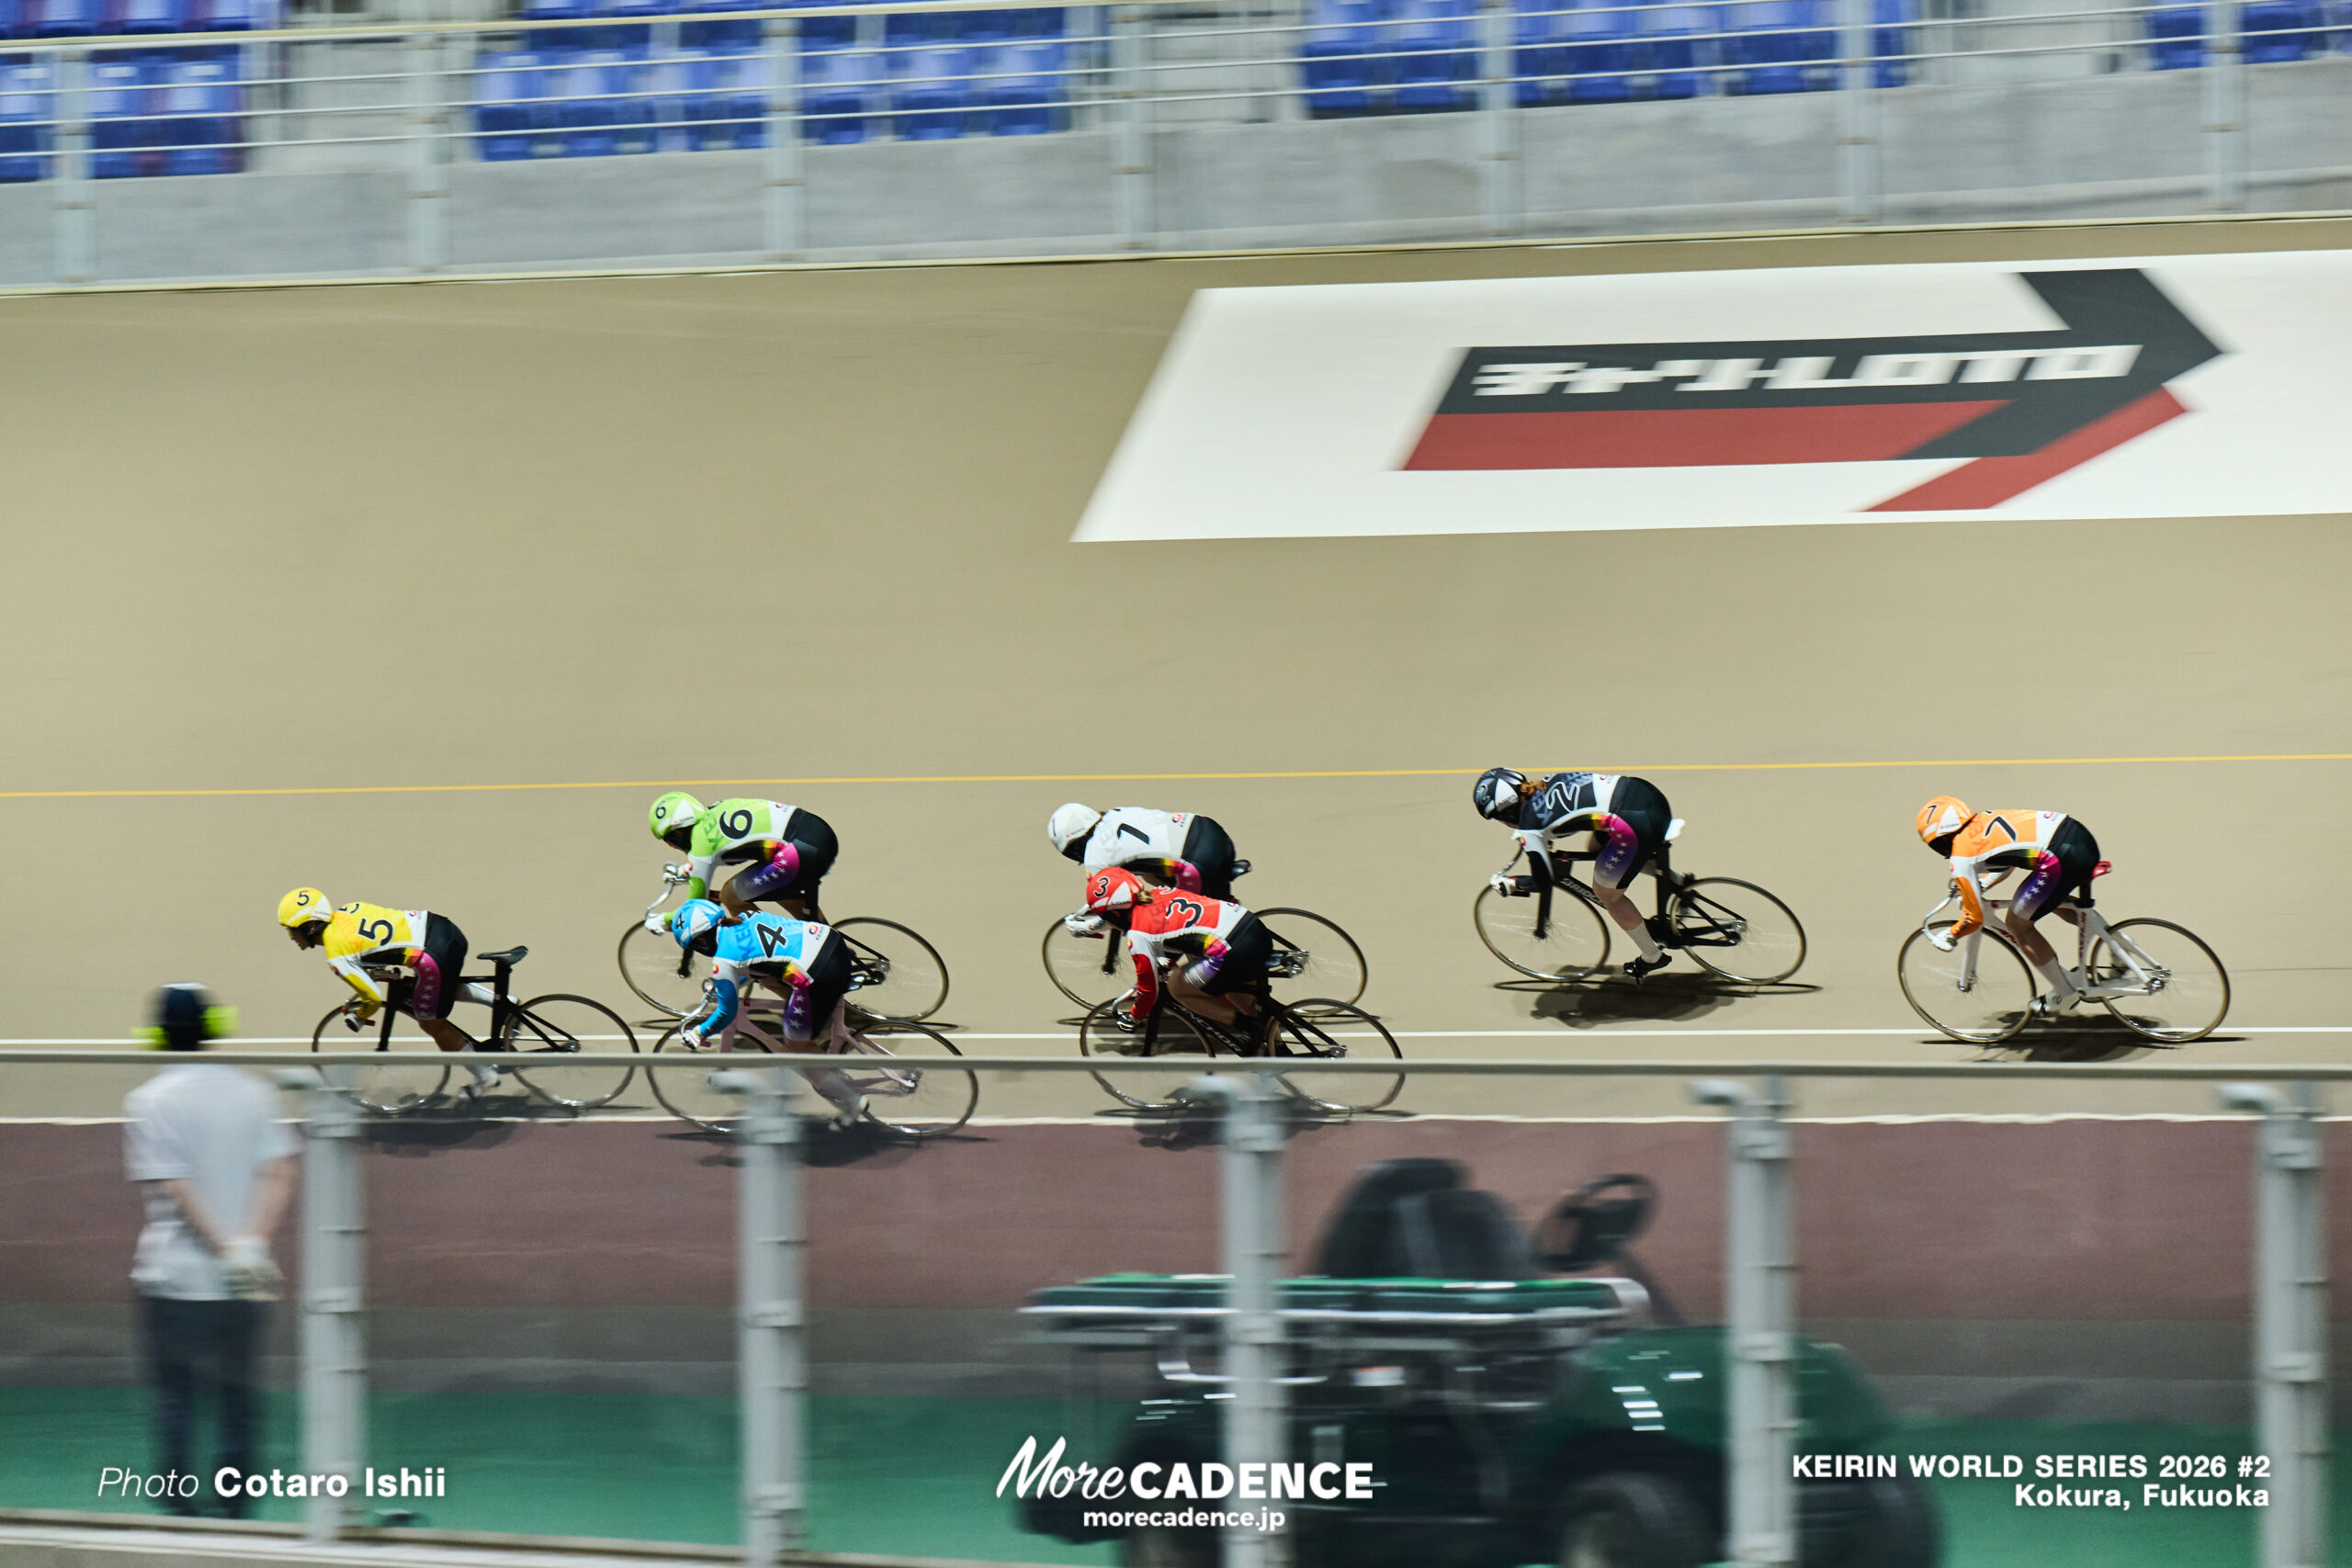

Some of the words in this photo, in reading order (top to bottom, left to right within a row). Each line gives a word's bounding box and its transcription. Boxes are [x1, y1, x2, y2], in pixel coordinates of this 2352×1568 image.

[655, 799, 668, 820] 6
[1544, 781, 1581, 813] 2
[719, 809, 753, 840] 6
[1926, 804, 1938, 825] 7
[1116, 822, 1150, 846] 1
[1984, 815, 2018, 843] 7
[296, 890, 310, 907] 5
[1093, 875, 1110, 898] 3
[675, 910, 686, 931] 4
[1165, 897, 1204, 929] 3
[357, 918, 394, 947] 5
[756, 922, 788, 959] 4
